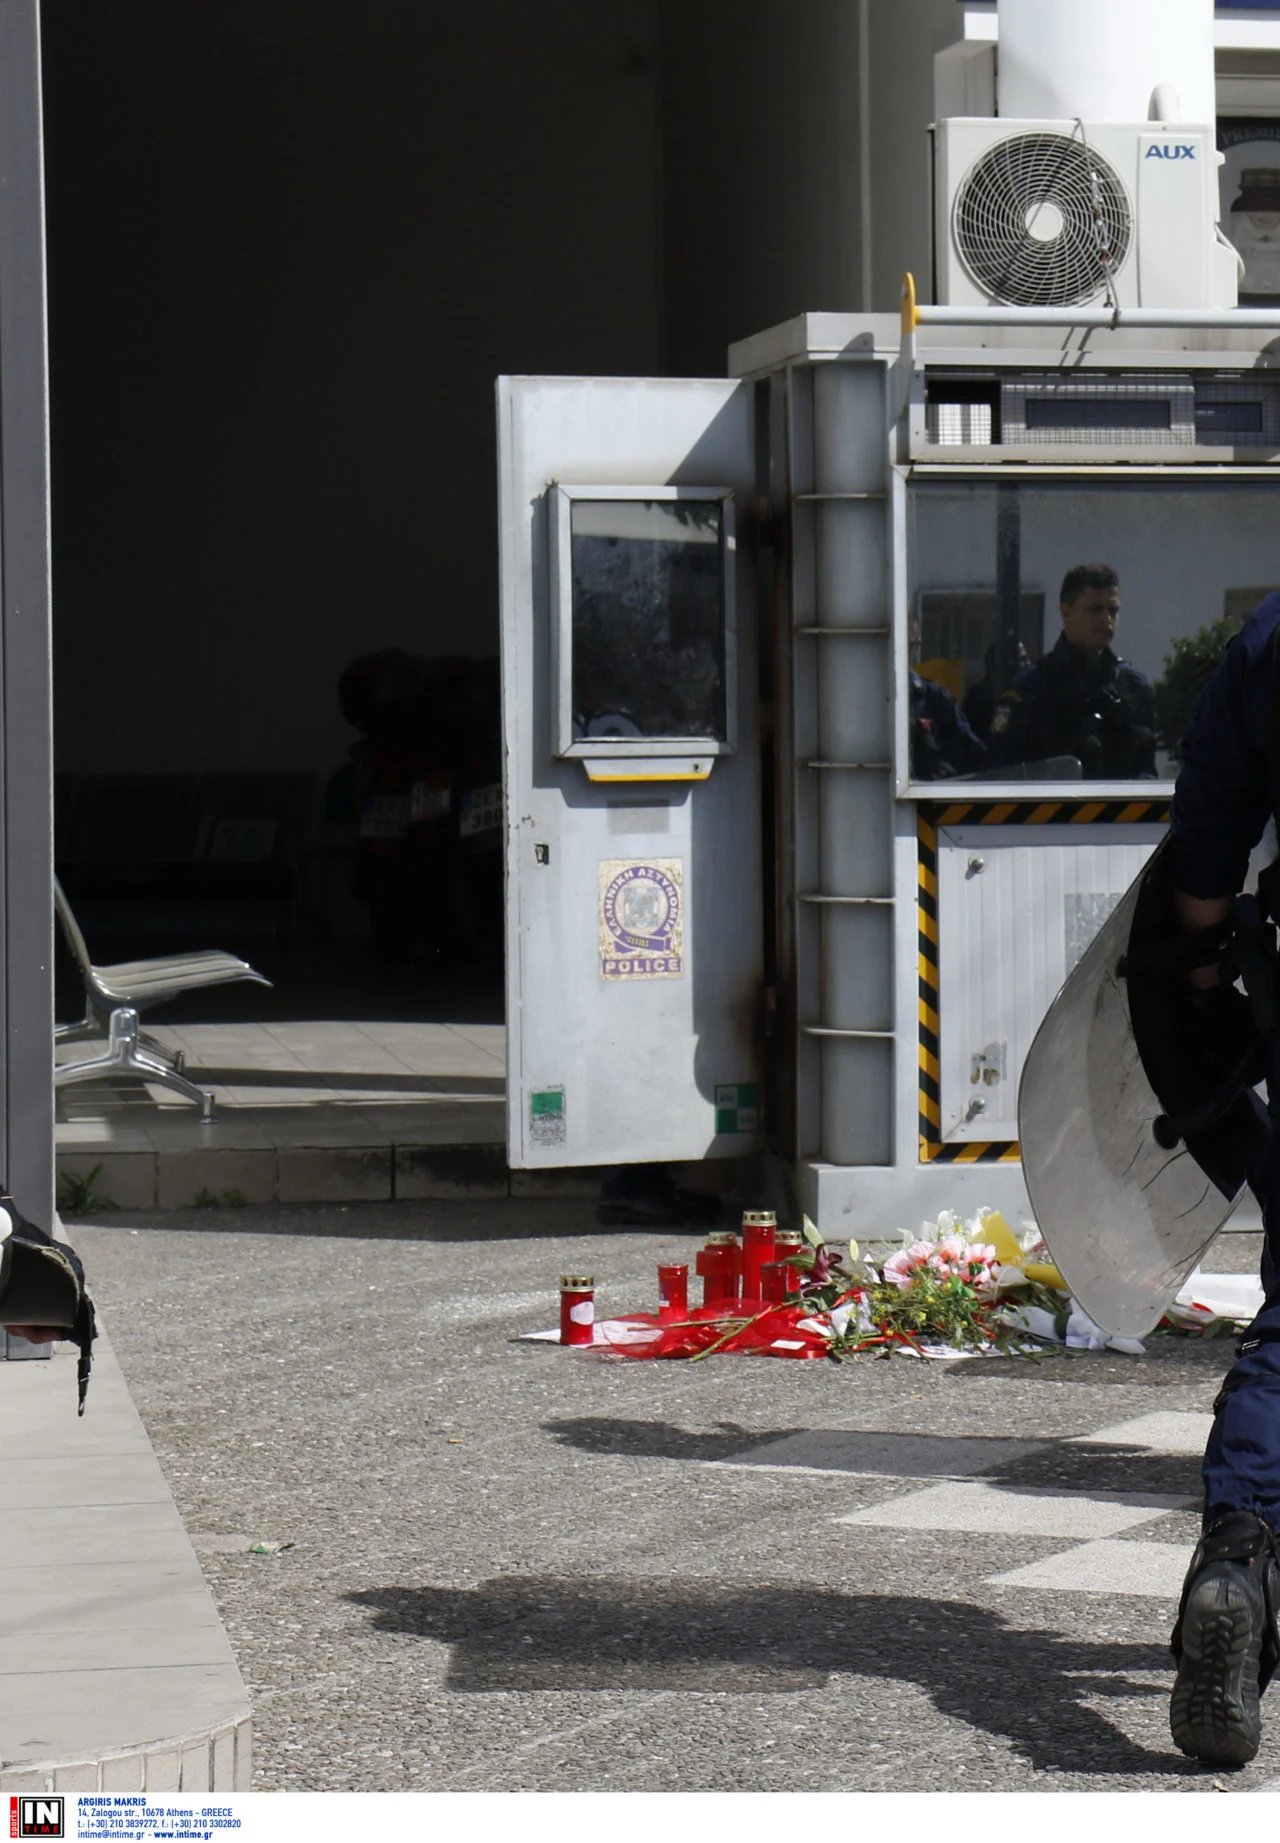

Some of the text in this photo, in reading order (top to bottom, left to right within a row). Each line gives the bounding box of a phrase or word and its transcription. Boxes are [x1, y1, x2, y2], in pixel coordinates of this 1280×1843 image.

[1145, 144, 1196, 160] AUX
[605, 868, 678, 937] ΕΛΛΗΝΙΚΗ ΑΣΤΥΝΟΜΙΑ
[605, 959, 679, 973] POLICE
